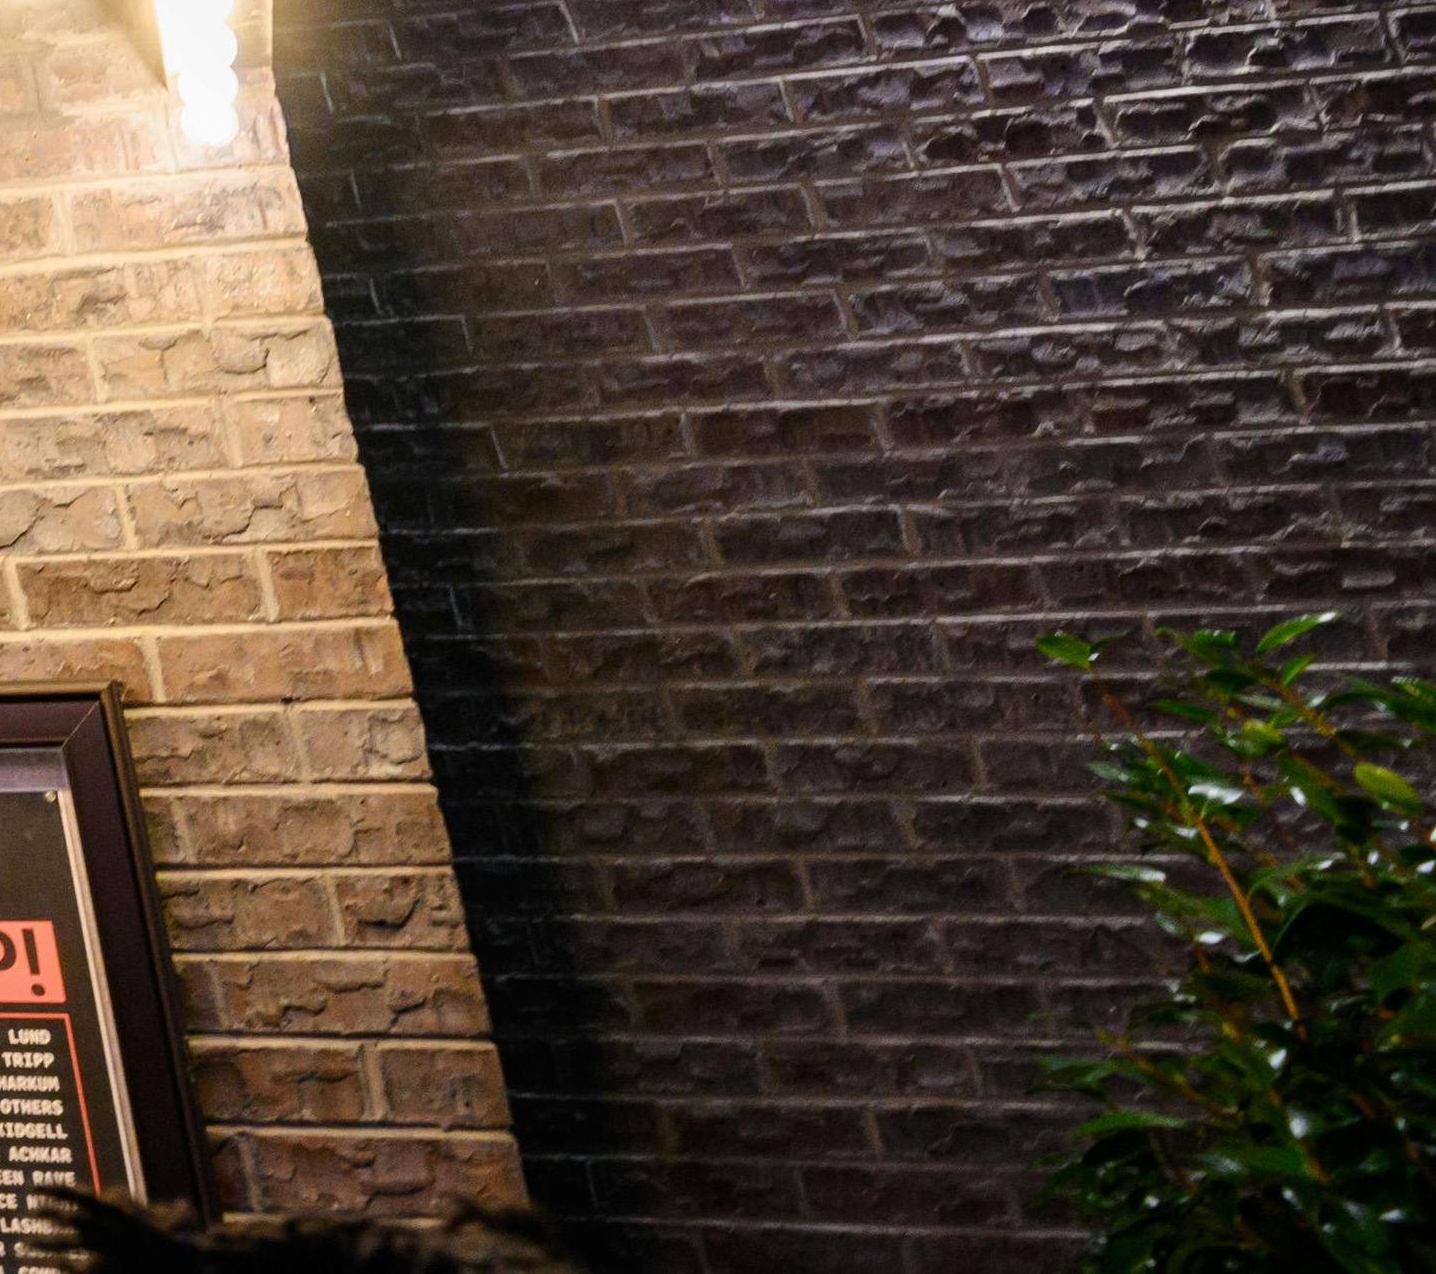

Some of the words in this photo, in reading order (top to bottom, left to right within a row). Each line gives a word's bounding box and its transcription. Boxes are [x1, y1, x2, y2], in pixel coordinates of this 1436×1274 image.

[8, 1029, 51, 1044] LUND
[1, 1052, 54, 1068] TRIPP
[0, 1098, 63, 1115] OTHERS
